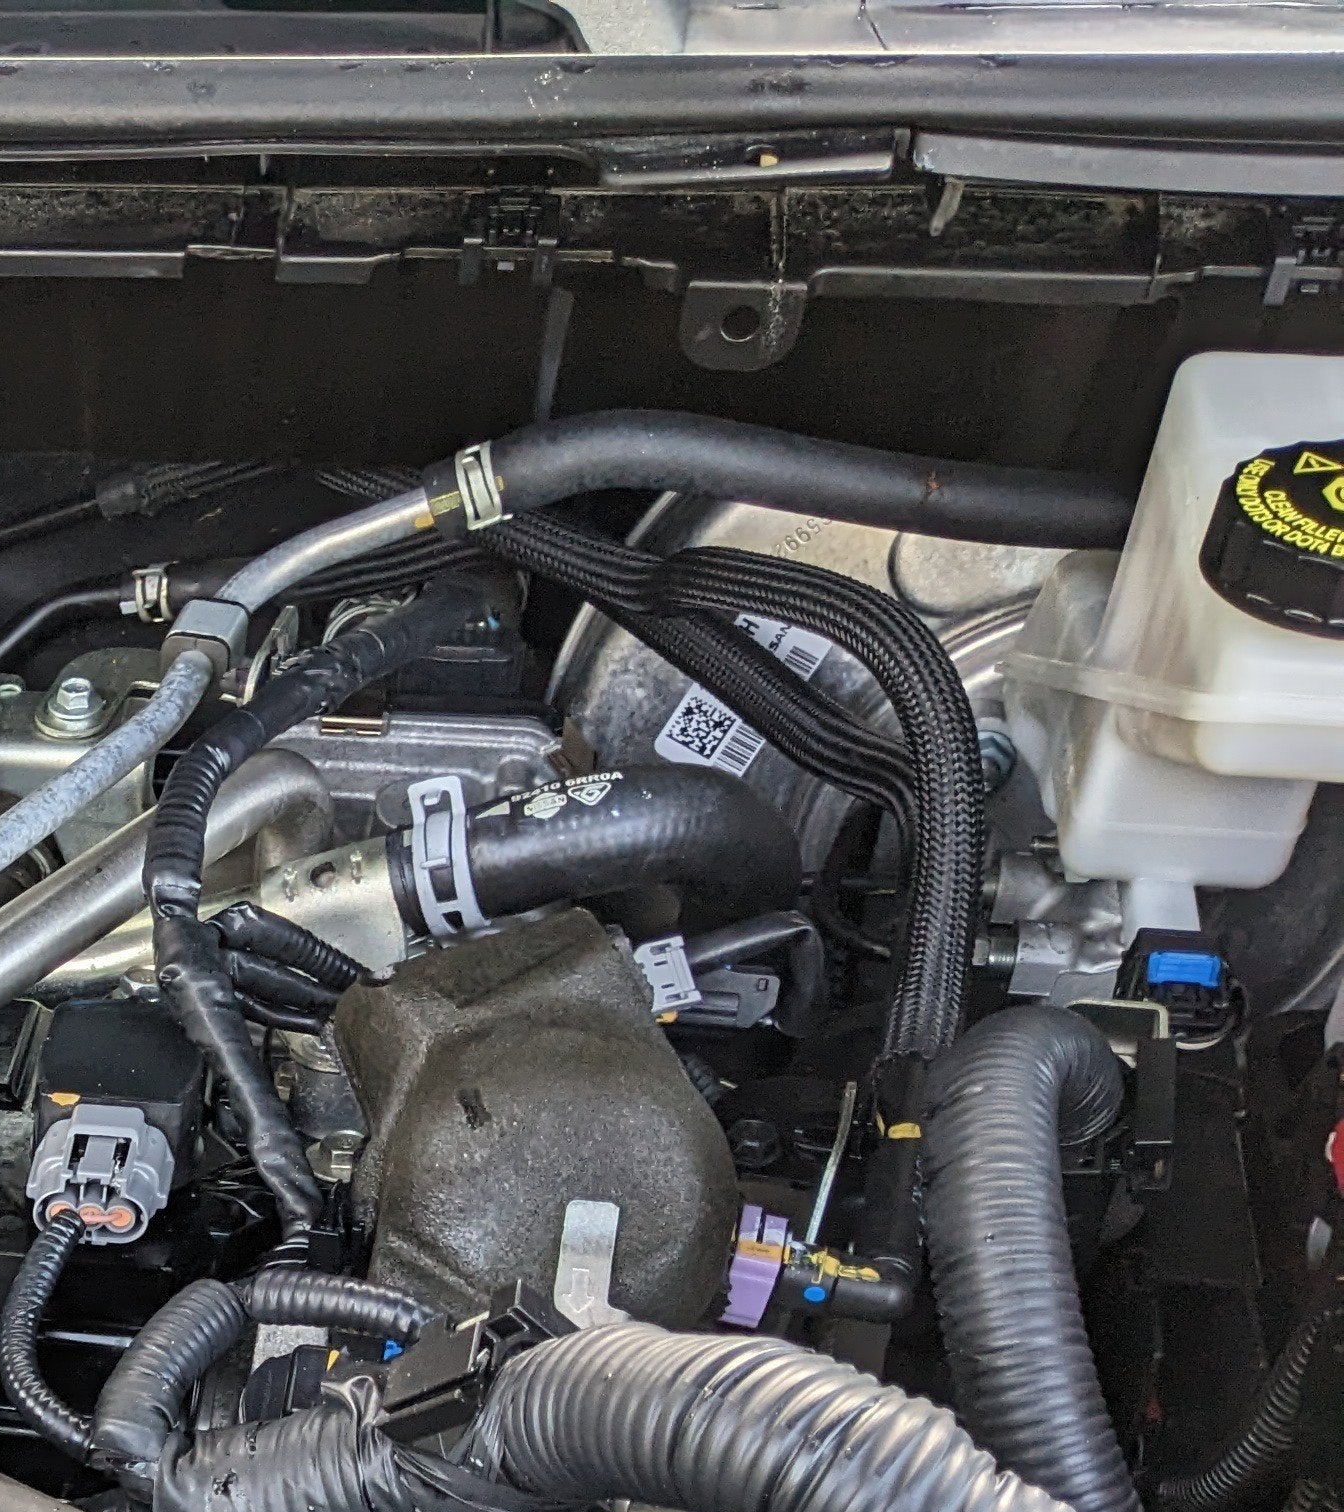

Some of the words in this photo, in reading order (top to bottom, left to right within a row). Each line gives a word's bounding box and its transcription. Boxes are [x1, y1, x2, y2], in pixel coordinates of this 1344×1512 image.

[1236, 474, 1261, 496] ONLY
[1239, 496, 1274, 522] DOT3
[1264, 490, 1303, 522] CLEAN
[1262, 519, 1291, 537] OR
[1283, 530, 1331, 554] DOT4
